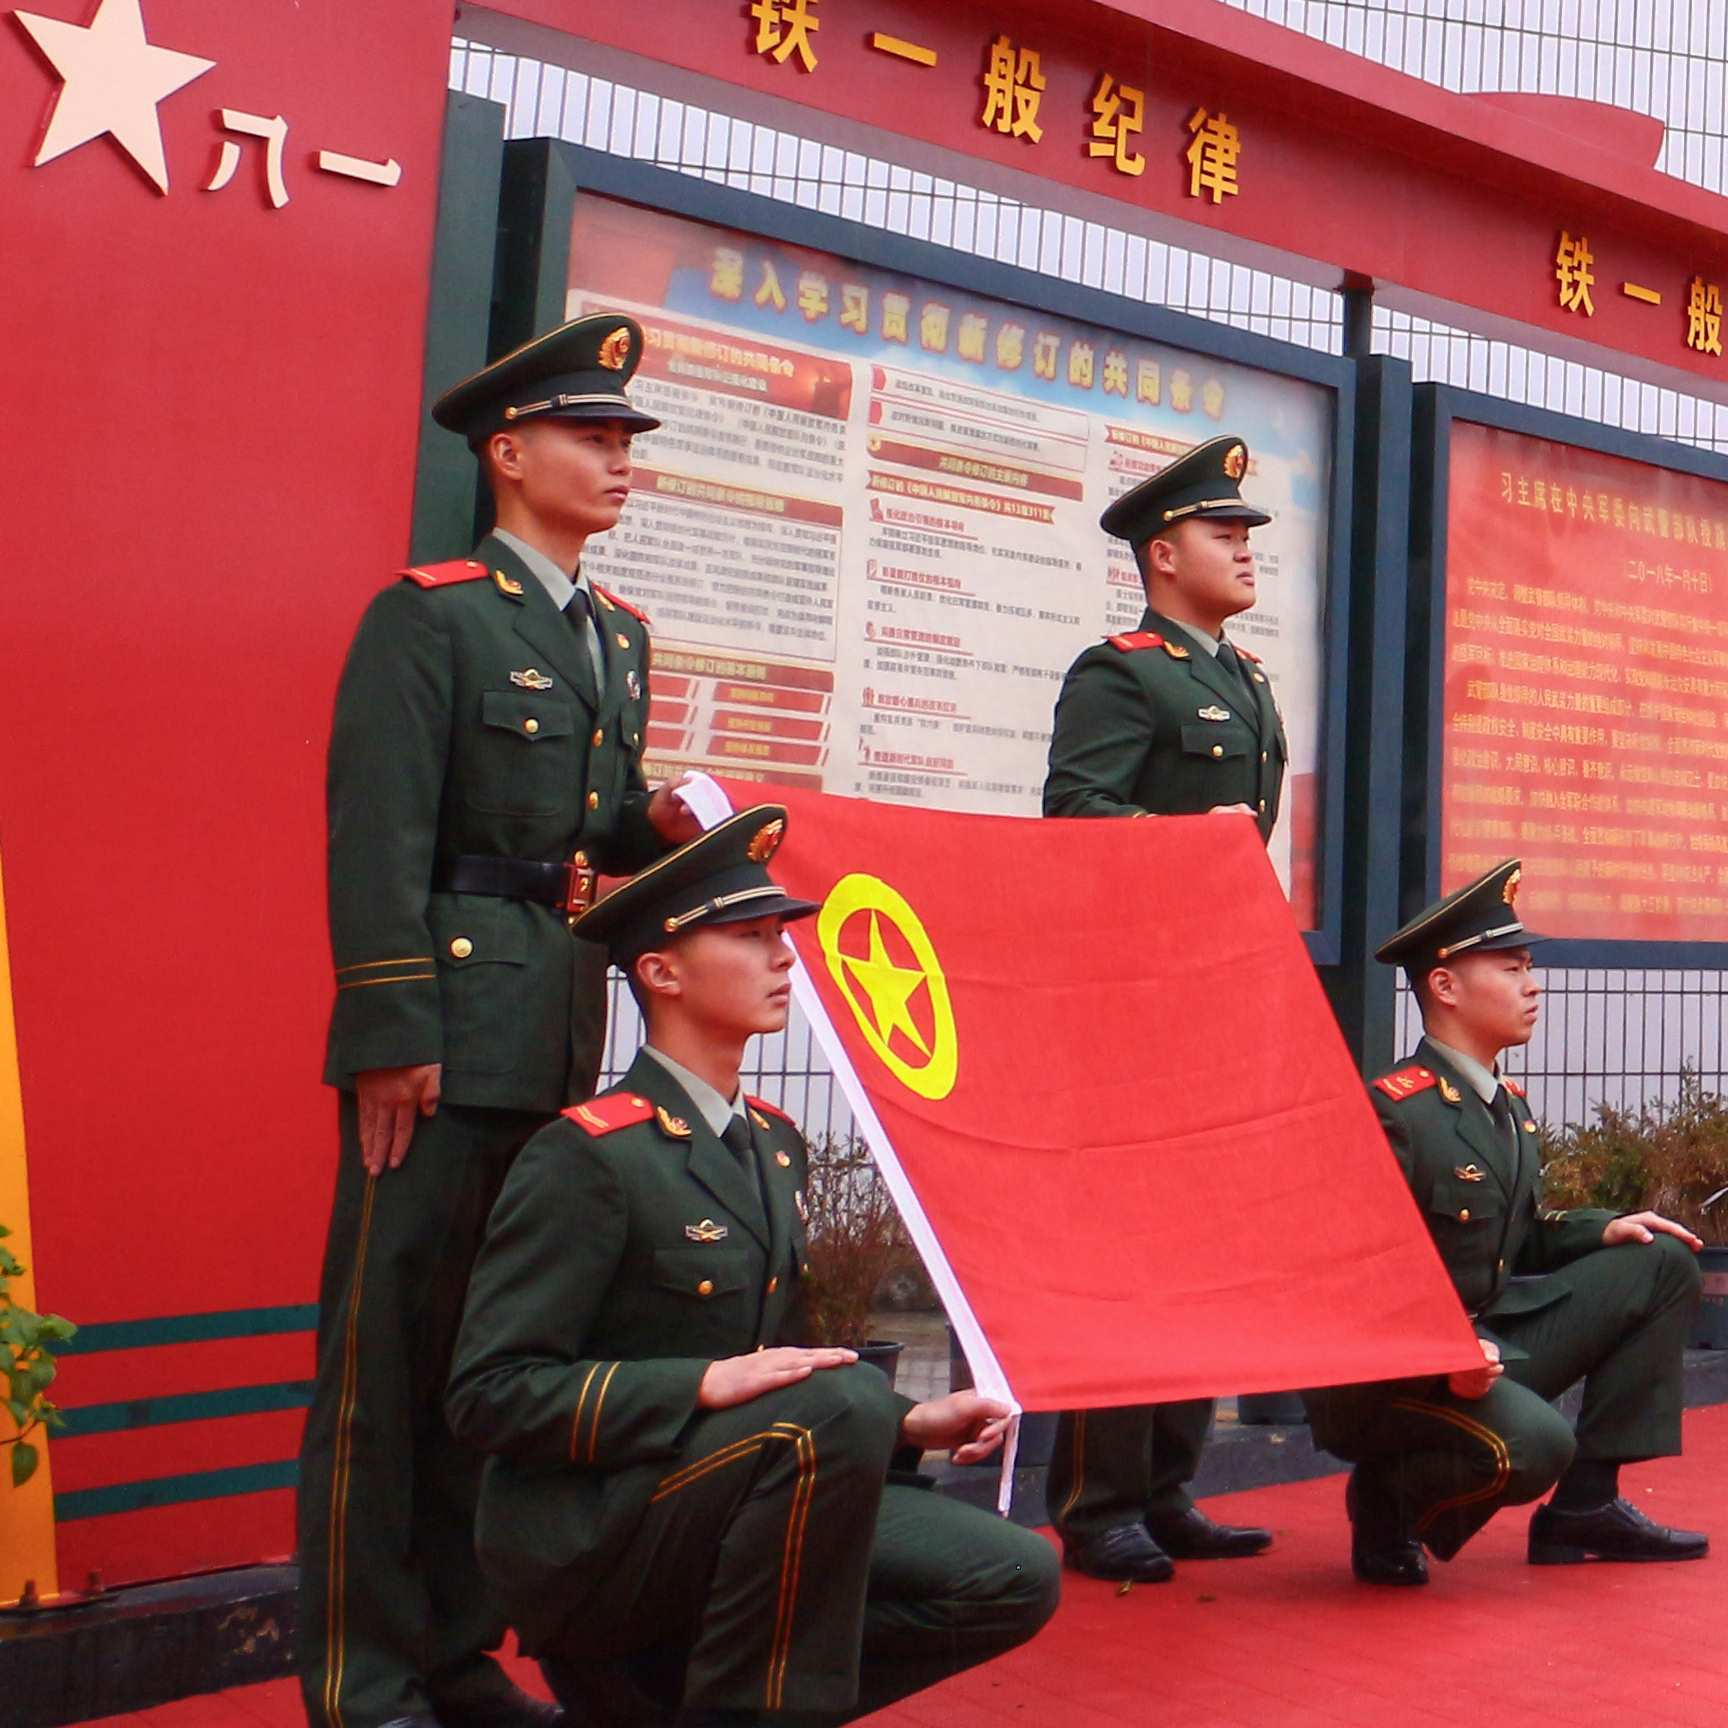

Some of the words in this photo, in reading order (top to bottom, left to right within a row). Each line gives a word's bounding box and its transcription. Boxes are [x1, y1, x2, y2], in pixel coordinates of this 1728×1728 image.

[205, 108, 402, 209] 八一
[709, 247, 1229, 421] 深入学习贯彻新修订的共同条令
